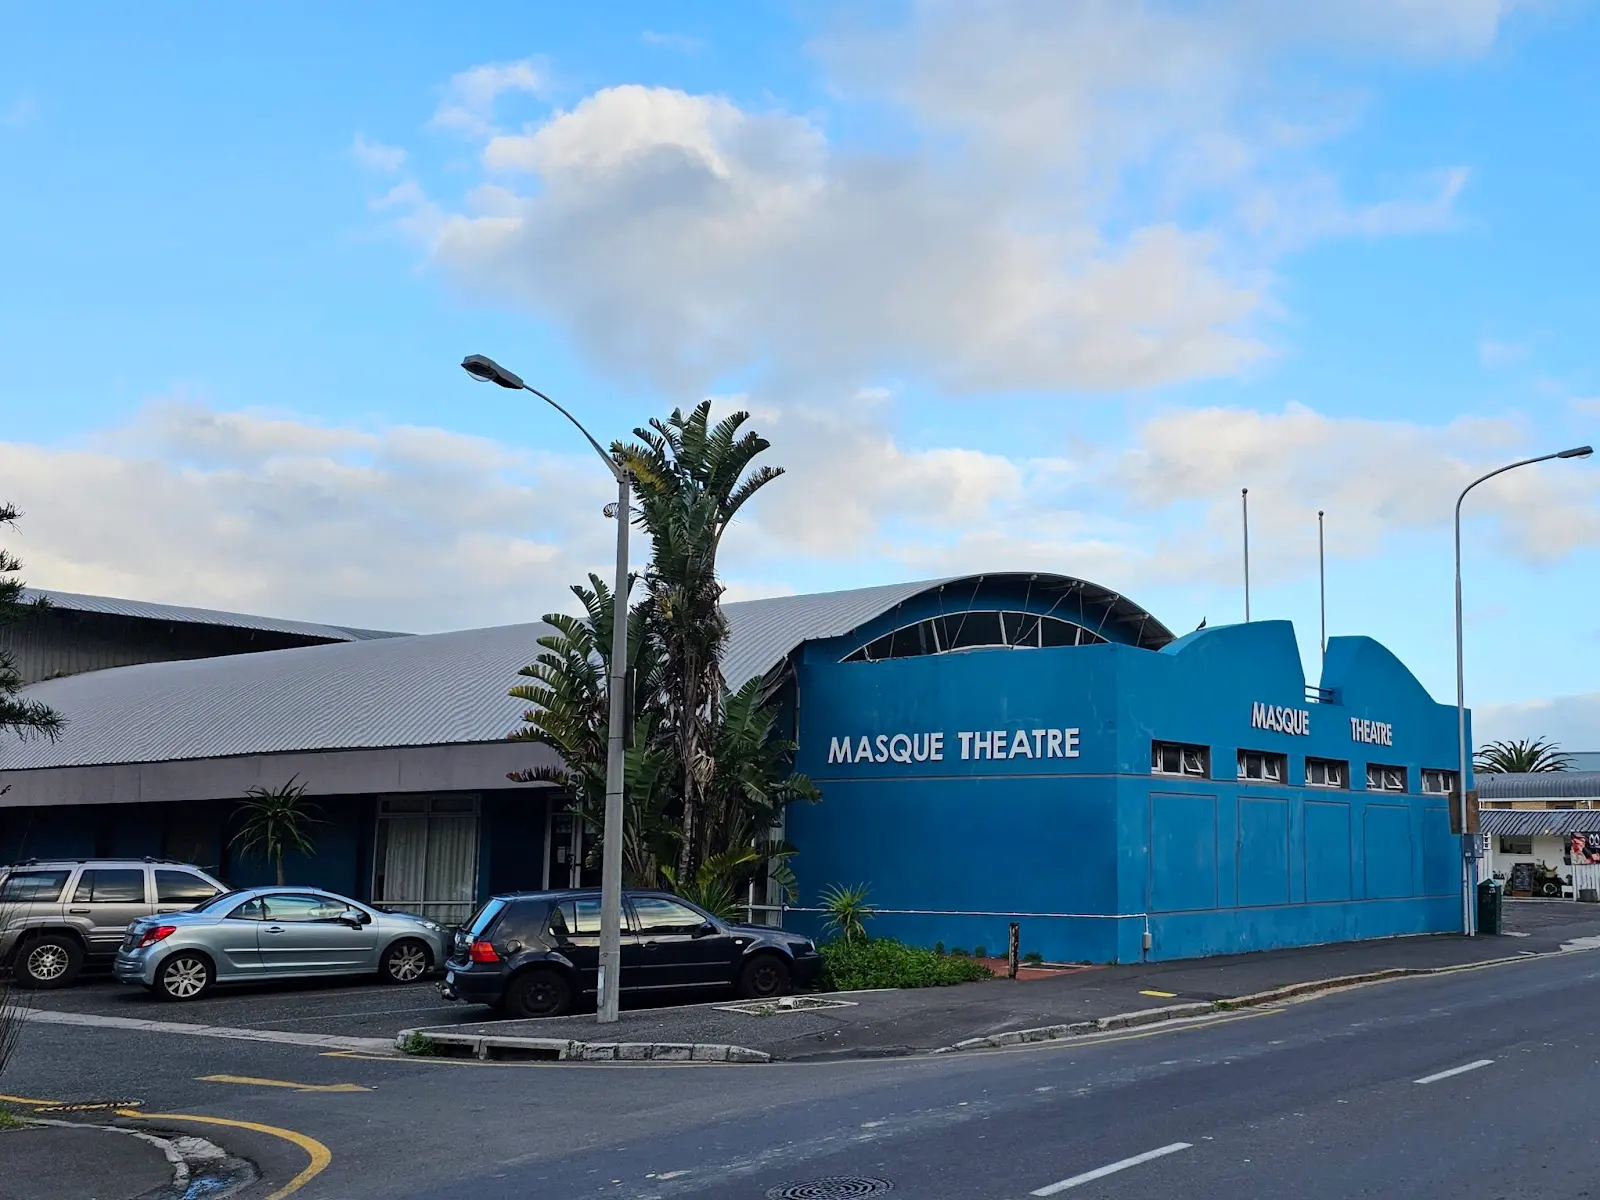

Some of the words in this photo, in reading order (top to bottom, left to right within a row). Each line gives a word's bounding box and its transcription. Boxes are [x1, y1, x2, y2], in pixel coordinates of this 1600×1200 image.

[1252, 702, 1310, 736] MASQUE
[1350, 717, 1393, 747] THEATRE
[828, 732, 944, 764] MASQUE
[958, 728, 1080, 760] THEATRE
